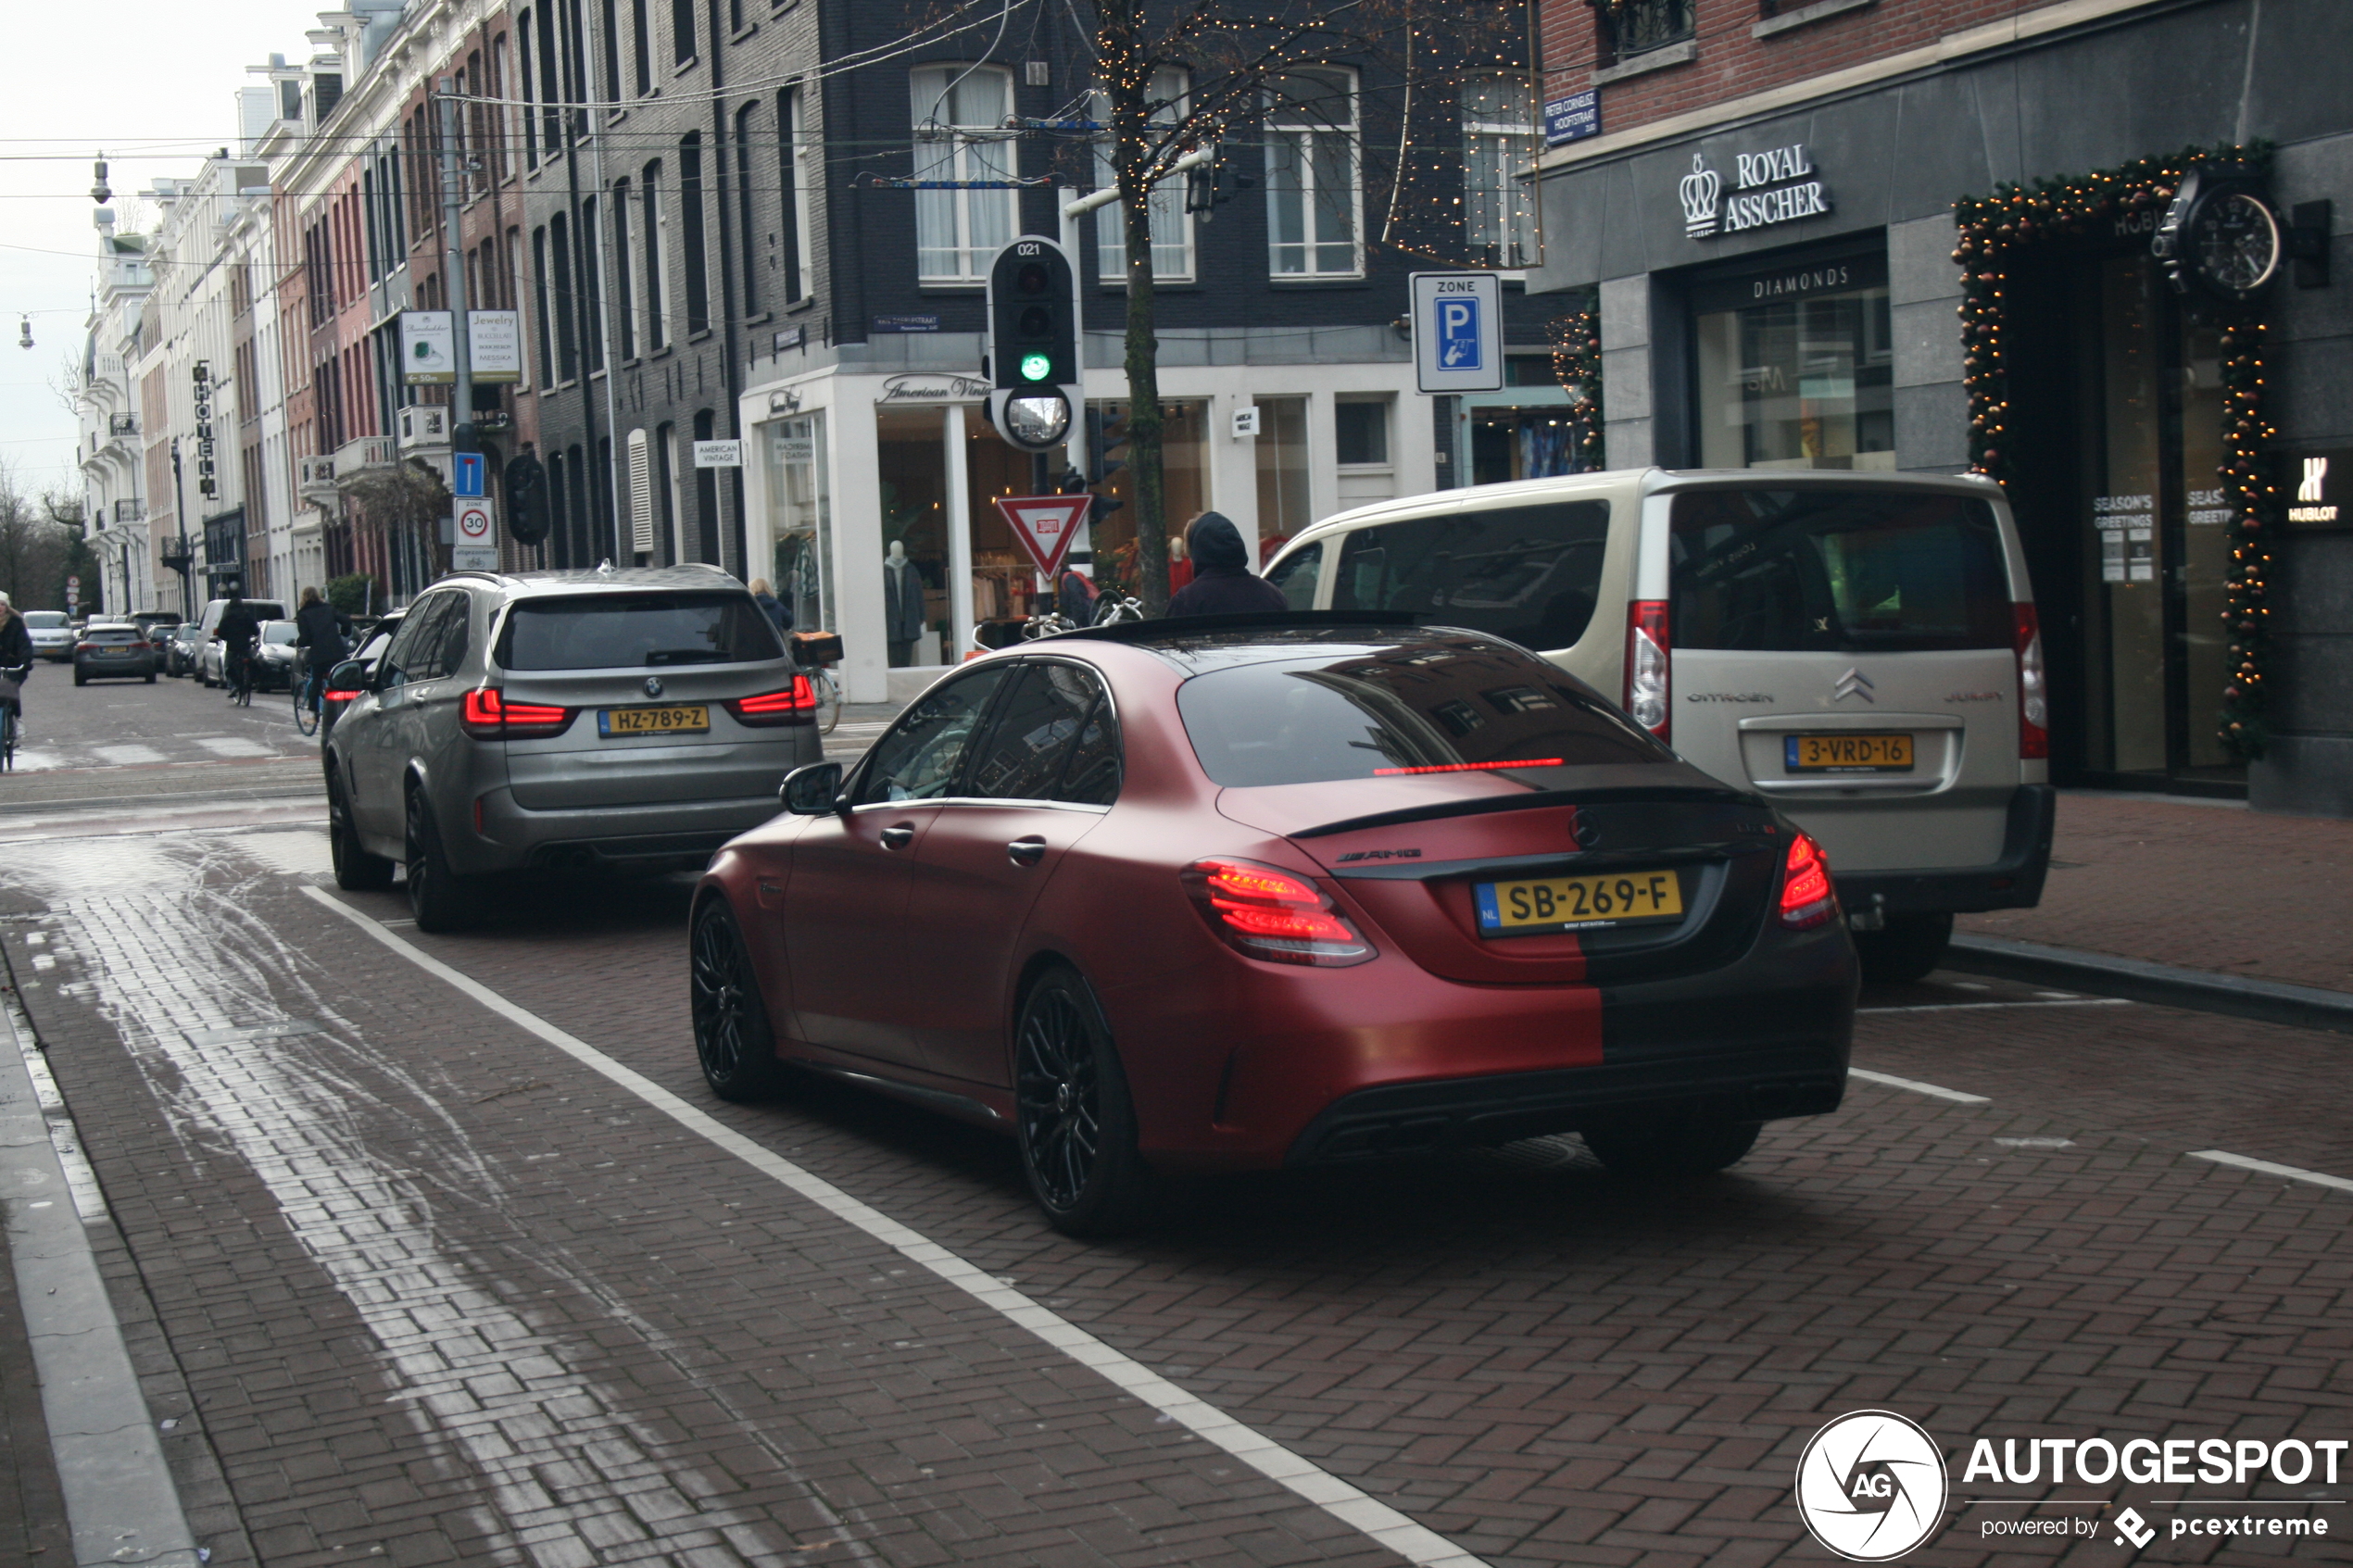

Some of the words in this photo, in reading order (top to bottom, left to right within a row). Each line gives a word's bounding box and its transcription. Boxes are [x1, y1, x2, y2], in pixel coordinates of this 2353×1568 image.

[1554, 108, 1595, 130] HOOFTSTRAAT
[1736, 144, 1812, 189] ROYAL
[1724, 182, 1829, 232] ASSCHER
[1017, 244, 1040, 257] 021
[1437, 281, 1476, 293] ZONE
[1754, 267, 1848, 298] DIAMONDS
[473, 314, 514, 327] Jewelry
[1445, 304, 1470, 340] P
[195, 385, 212, 475] HOTEL
[699, 445, 738, 454] AMERICAN
[703, 454, 735, 462] VINTAGE
[2094, 495, 2153, 511] SEASON'S
[2095, 513, 2153, 530] GREETINGS
[2288, 506, 2338, 522] HUBLOT
[466, 517, 484, 529] 30
[456, 548, 497, 557] uitgezonderd
[618, 709, 702, 730] HZ-789-Z
[1807, 740, 1903, 761] 3-VRD-16
[1482, 909, 1497, 920] NL
[1509, 876, 1667, 920] SB-269-F
